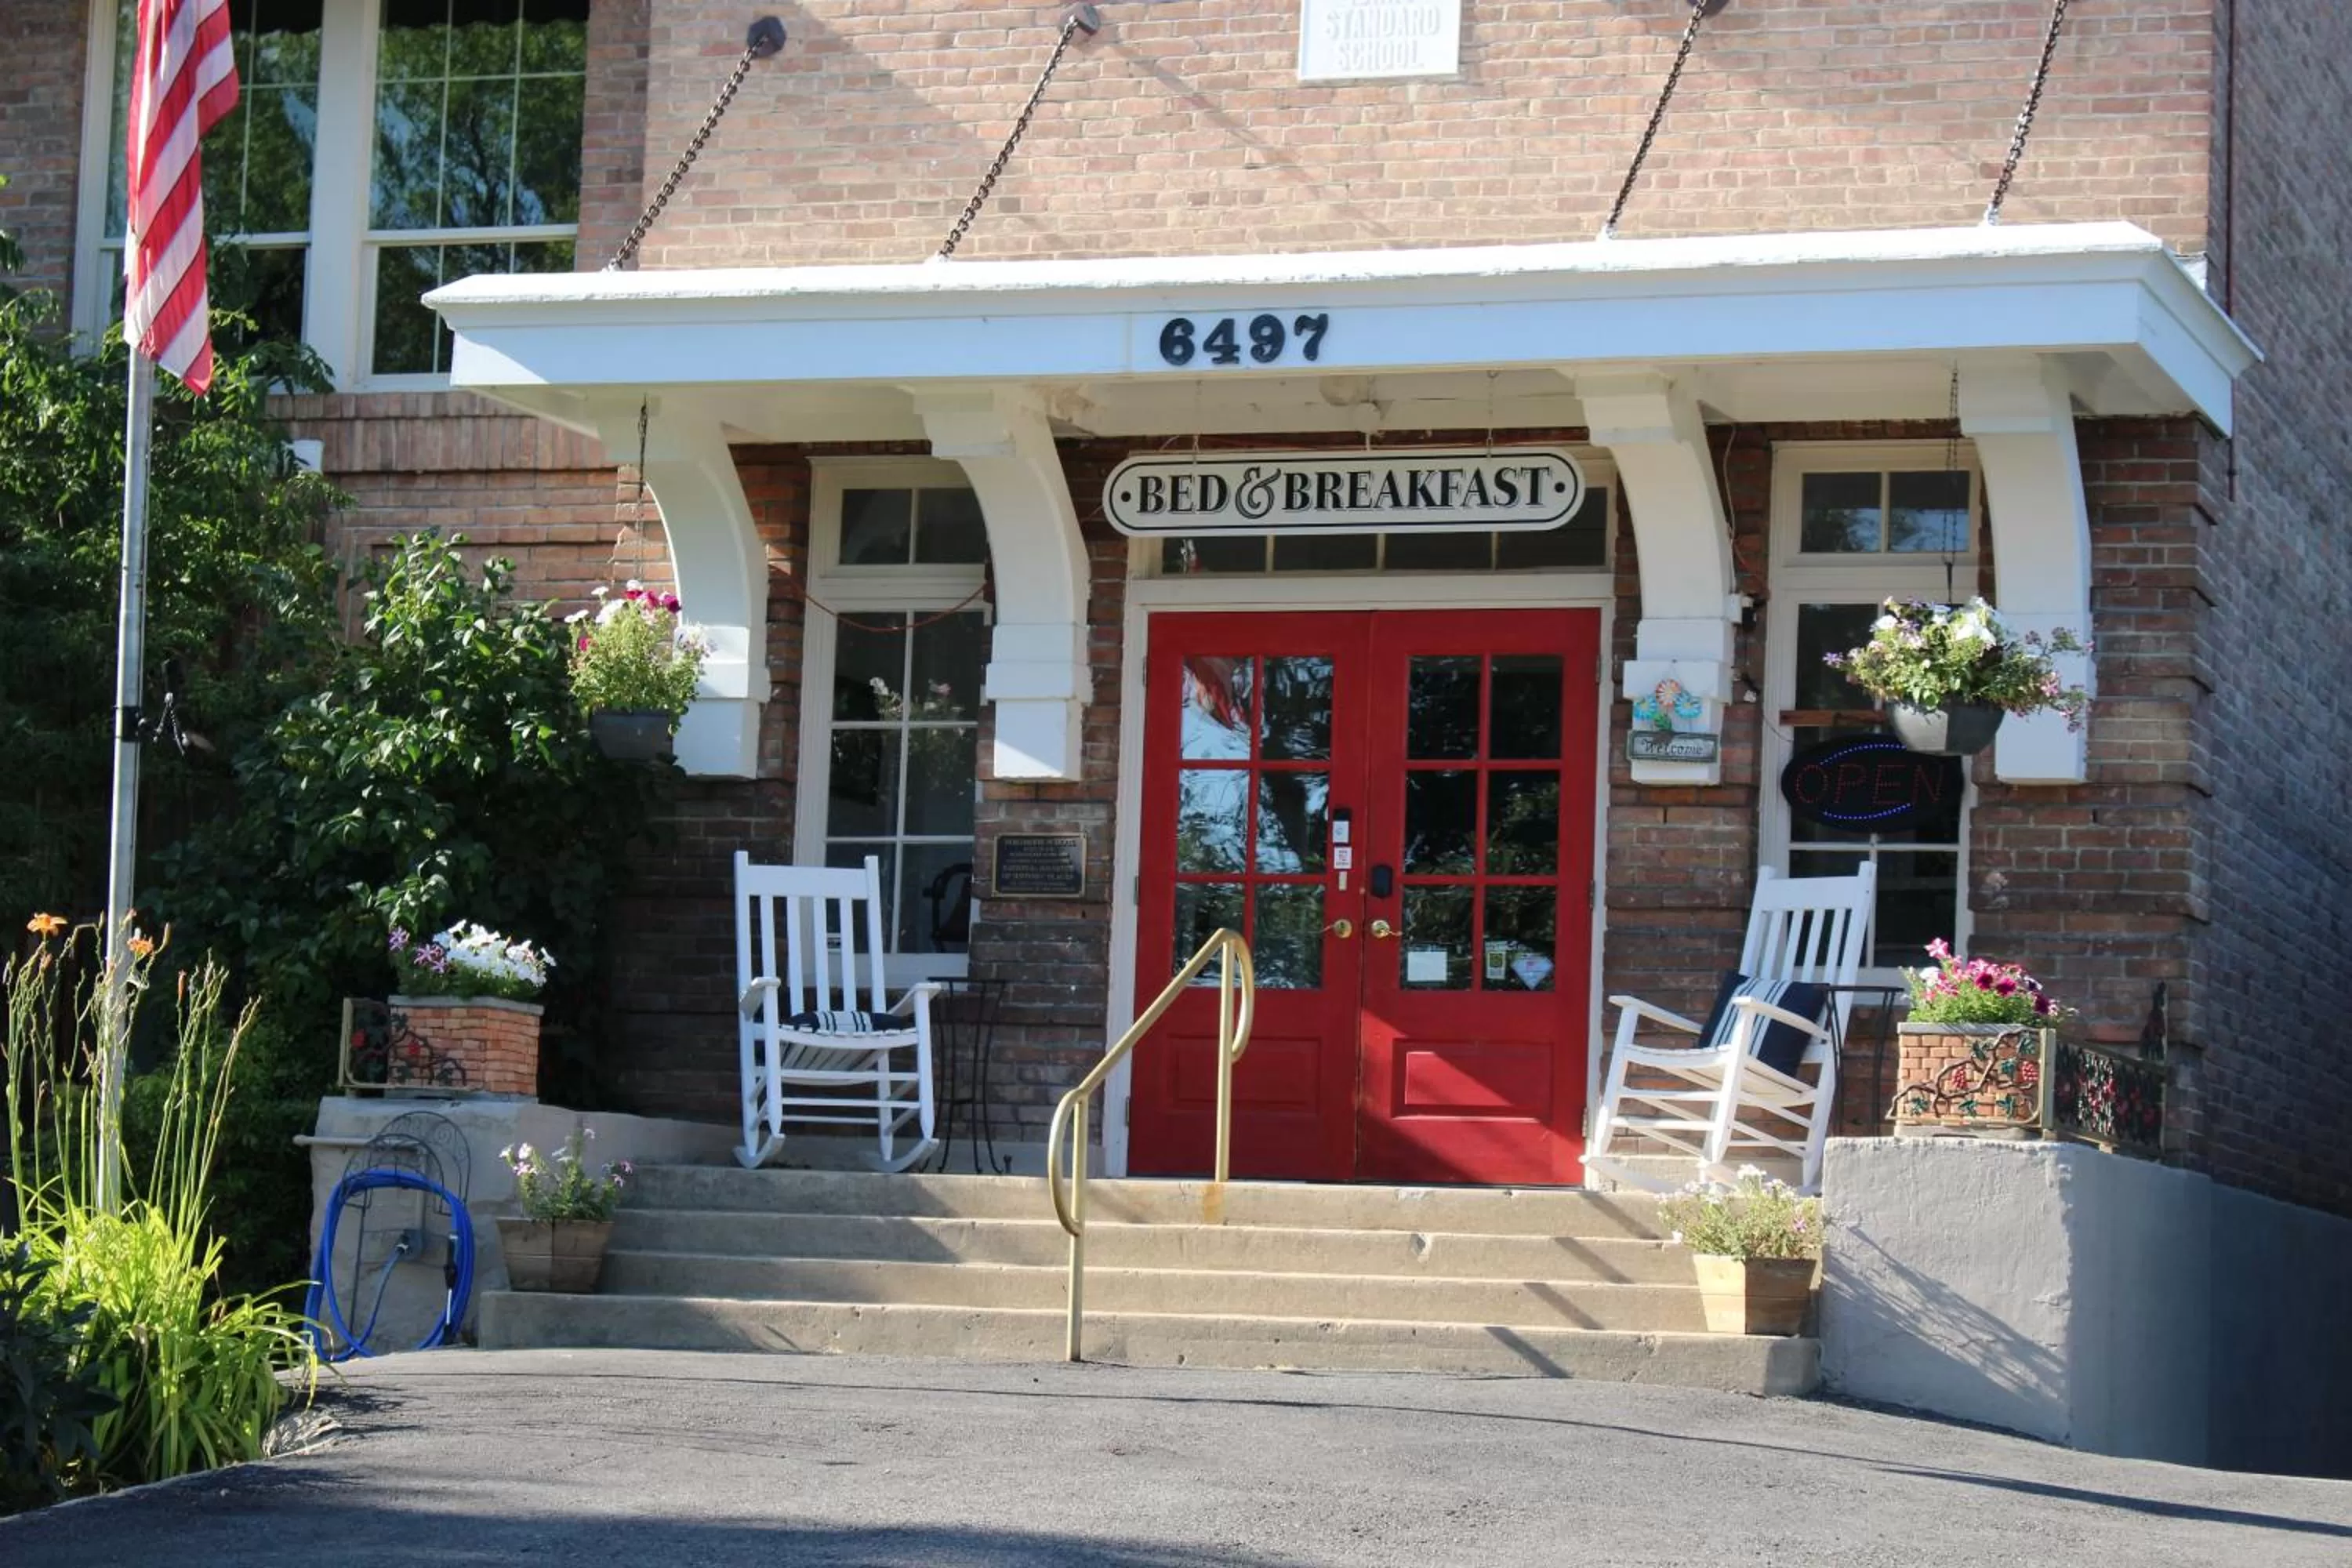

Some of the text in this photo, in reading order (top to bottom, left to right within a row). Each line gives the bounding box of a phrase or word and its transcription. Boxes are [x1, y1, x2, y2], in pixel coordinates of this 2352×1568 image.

[1325, 6, 1440, 39] STANDARD
[1338, 40, 1425, 71] SCHOOL
[1160, 313, 1330, 366] 6497
[1641, 738, 1704, 755] Welcome
[1795, 764, 1944, 805] OPEN
